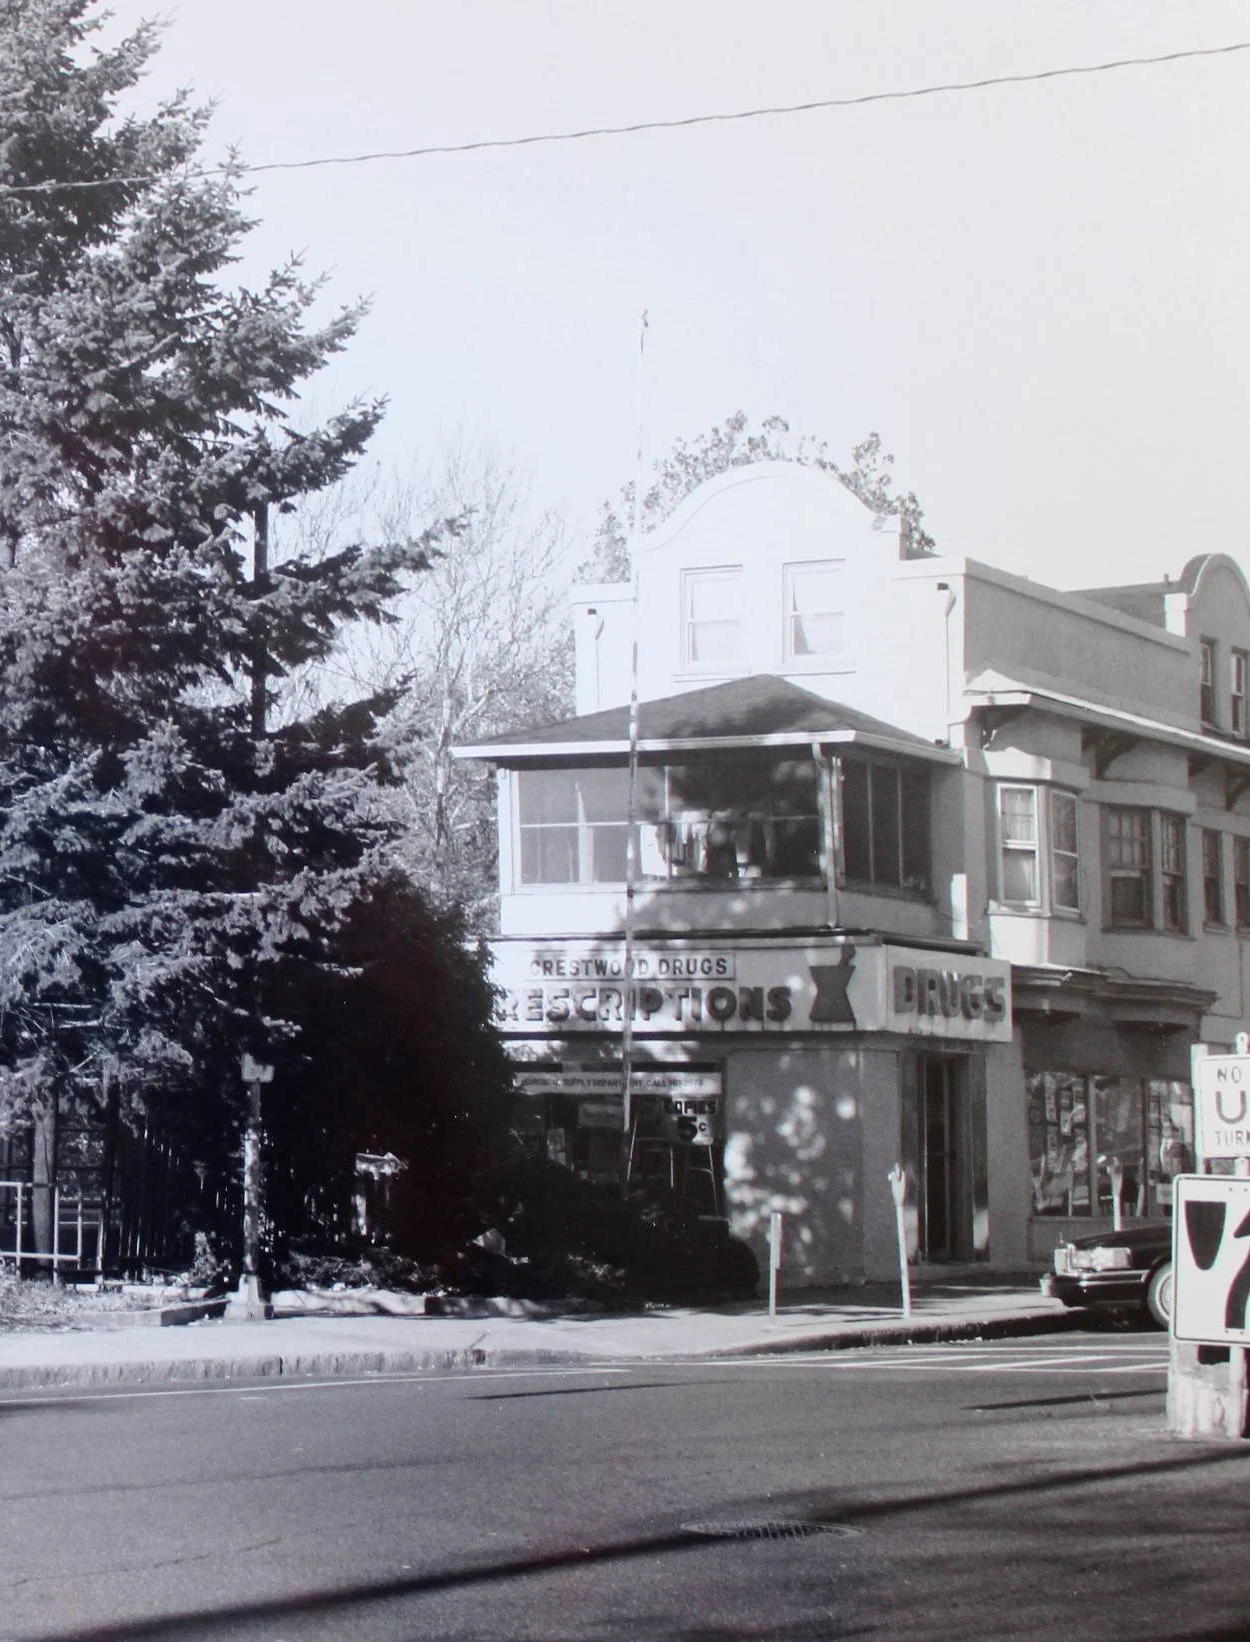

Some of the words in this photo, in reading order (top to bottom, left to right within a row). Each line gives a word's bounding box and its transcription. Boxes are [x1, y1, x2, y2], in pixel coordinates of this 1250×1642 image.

[658, 958, 728, 976] DRUGS
[893, 965, 1006, 1022] DRUGS
[495, 985, 792, 1022] RESCRIPTIONS
[563, 1078, 592, 1087] SUPPLY
[593, 1078, 642, 1087] DEPARTNT
[1217, 1066, 1242, 1083] NO
[665, 1101, 716, 1114] COPIES
[1215, 1090, 1247, 1124] U
